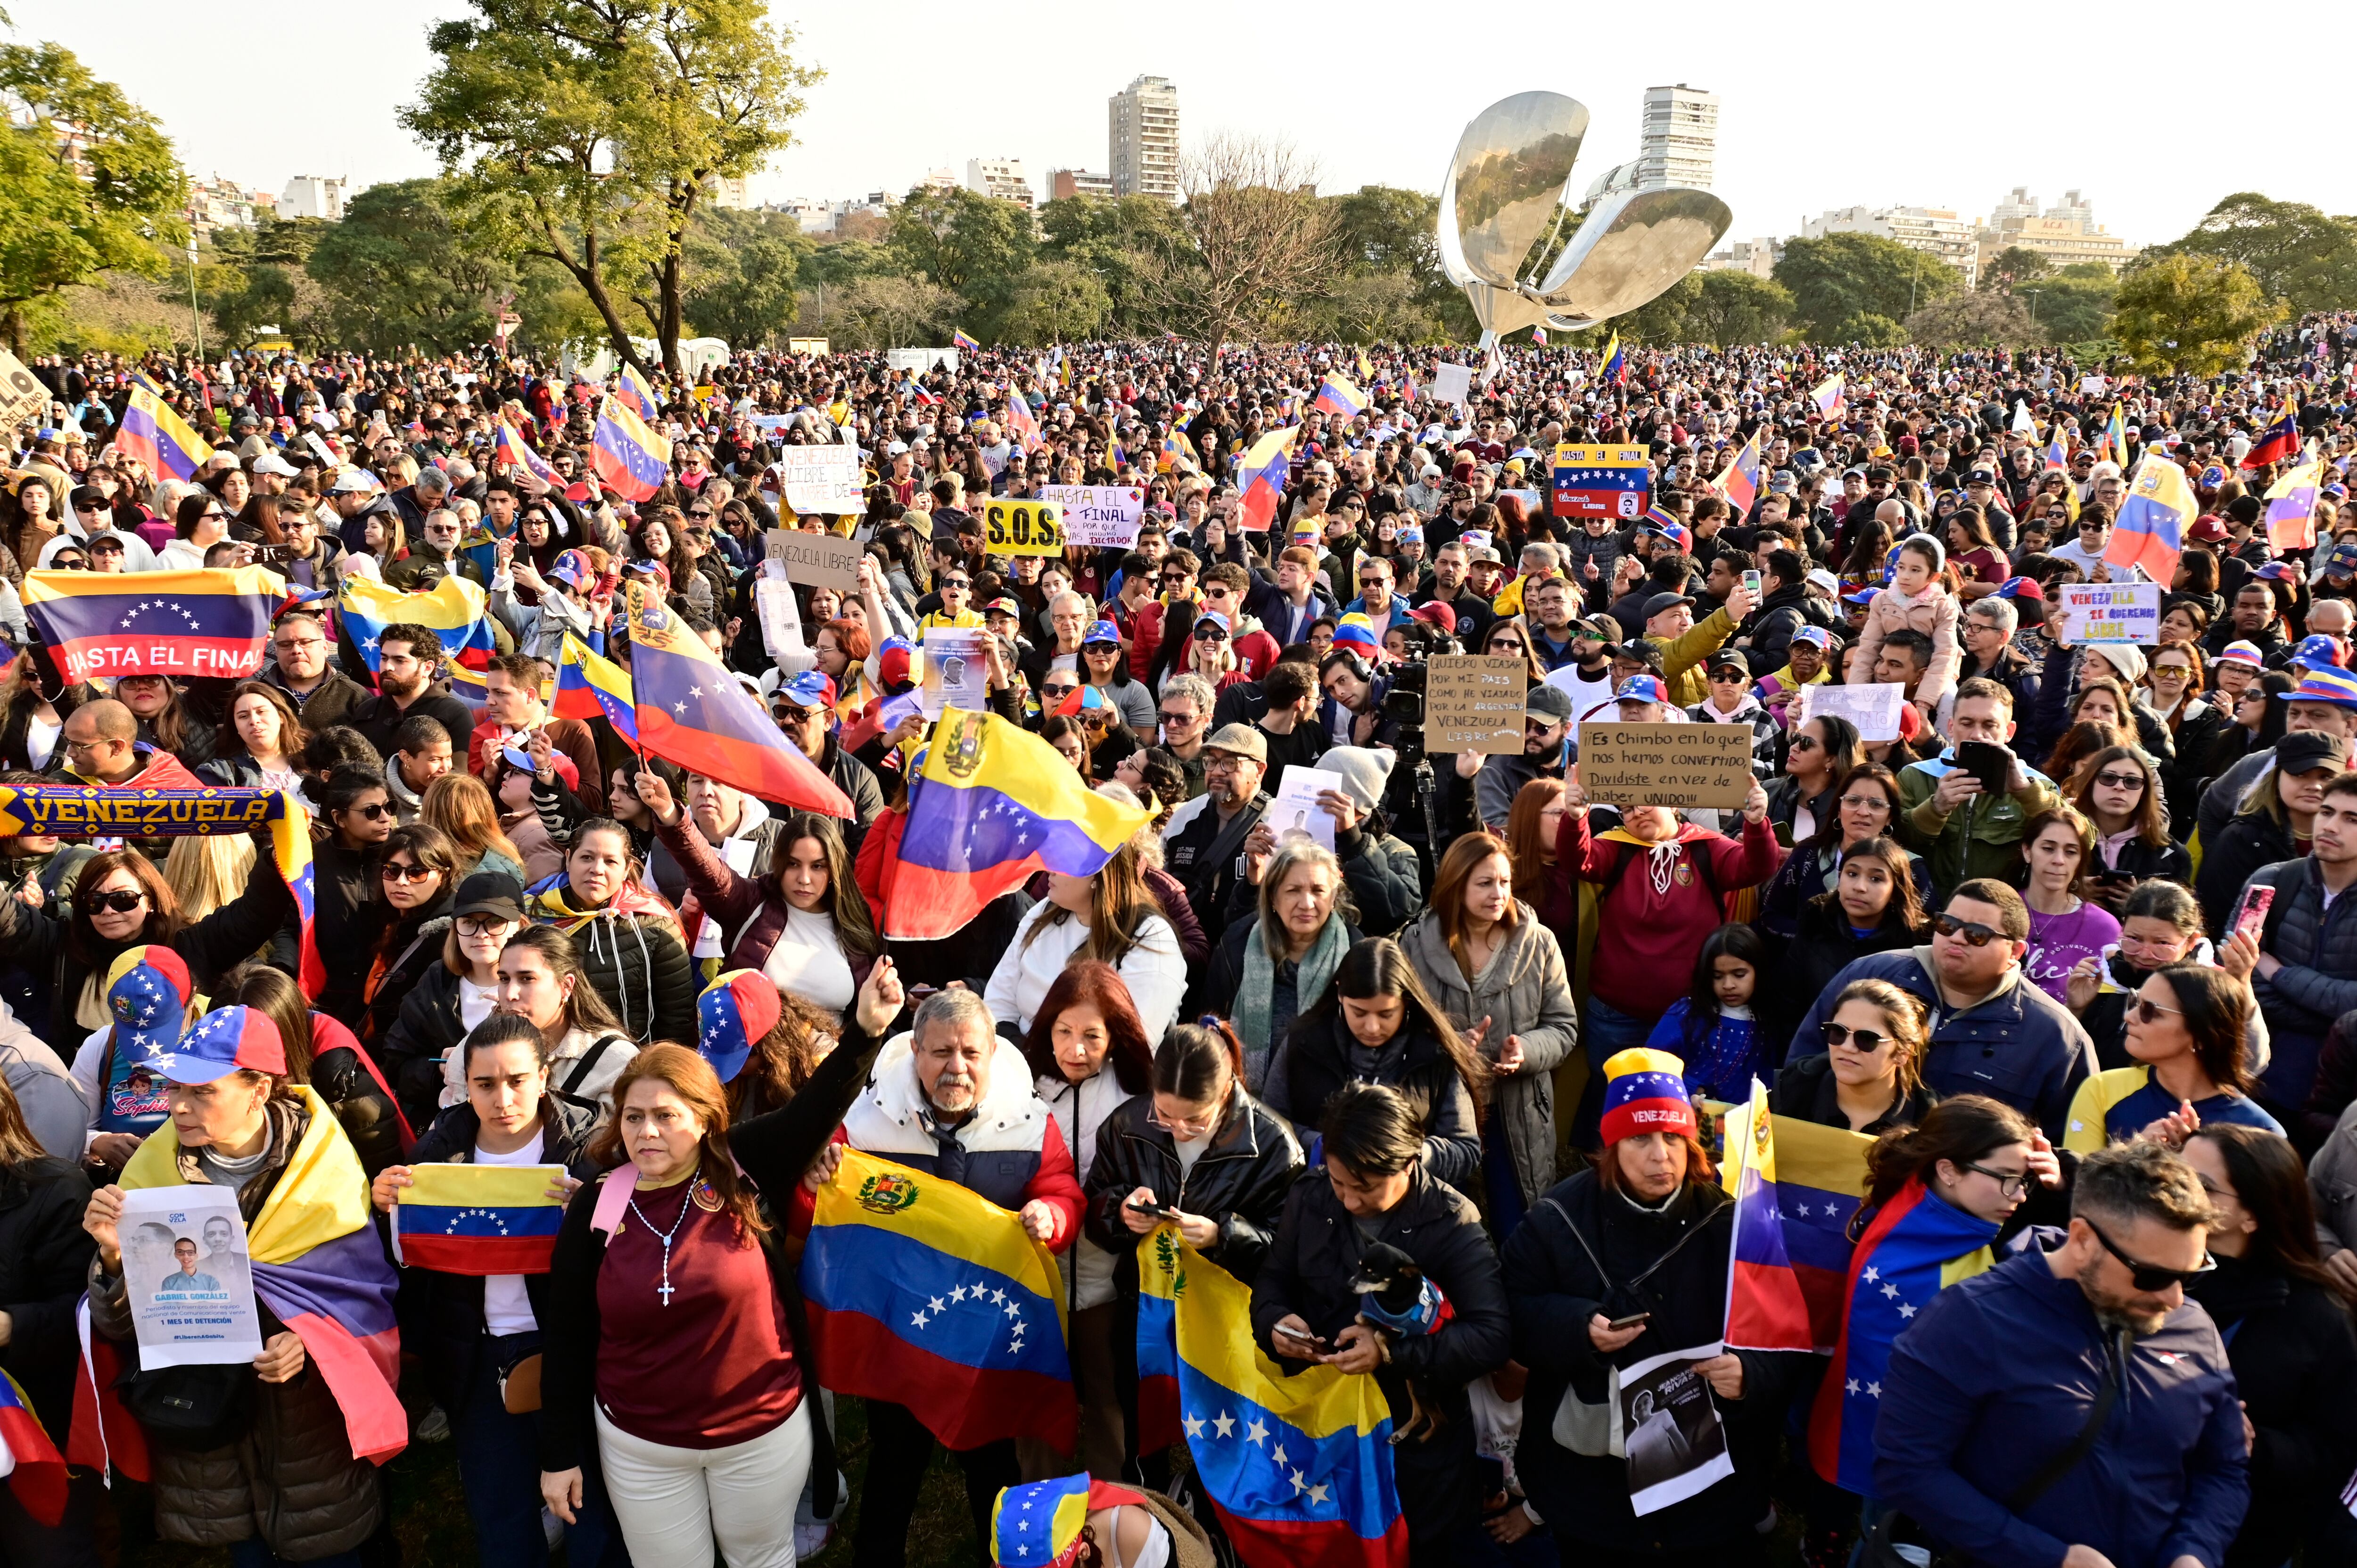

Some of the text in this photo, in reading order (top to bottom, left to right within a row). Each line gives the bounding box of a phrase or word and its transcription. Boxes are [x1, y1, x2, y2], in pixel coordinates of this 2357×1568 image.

[1, 392, 43, 428] DEL PINO
[783, 448, 854, 465] VENEZUELA
[1561, 451, 1640, 460] HASTA EL FINAL
[788, 466, 827, 484] LIBRE
[847, 466, 859, 481] EL
[835, 484, 849, 498] DE
[1048, 489, 1122, 507] HASTA EL
[1559, 493, 1589, 502] Venezuela
[988, 506, 1063, 547] S.O.S.
[1101, 523, 1117, 531] QUE
[1089, 536, 1132, 545] DICTADOR
[766, 543, 854, 572] VENEZUELA LIBRE
[2070, 591, 2135, 605] VENEZUELA
[2090, 608, 2156, 619] TE QUEREMOS
[150, 647, 184, 665] EL
[1430, 657, 1522, 670] QUIERO VIAJAR
[1430, 674, 1510, 685] POR MI PAIS
[1429, 689, 1523, 698] COMO HE VIAJADO
[1429, 702, 1449, 712] POR
[1474, 702, 1524, 711] ARGENTINA
[1436, 715, 1507, 728] VENEZUELA
[1447, 732, 1490, 742] LIBRE
[1616, 731, 1673, 745] Chimbo
[1678, 734, 1697, 745] en
[1703, 731, 1714, 745] lo
[1718, 734, 1745, 751] que
[1592, 753, 1615, 764] nos
[1622, 750, 1664, 764] hemos
[1588, 771, 1651, 786] Dividiste
[1659, 776, 1678, 785] en
[1714, 774, 1731, 787] de
[1591, 789, 1698, 805] haber UNIDO!!!
[23, 798, 269, 822] VENEZUELA
[2051, 944, 2093, 955] MOTIVATES
[2021, 948, 2068, 979] he
[1631, 1110, 1687, 1125] VENEZUELA
[155, 1292, 228, 1301] GABRIEL GONZÁLEZ
[1665, 1372, 1695, 1396] RIVAS
